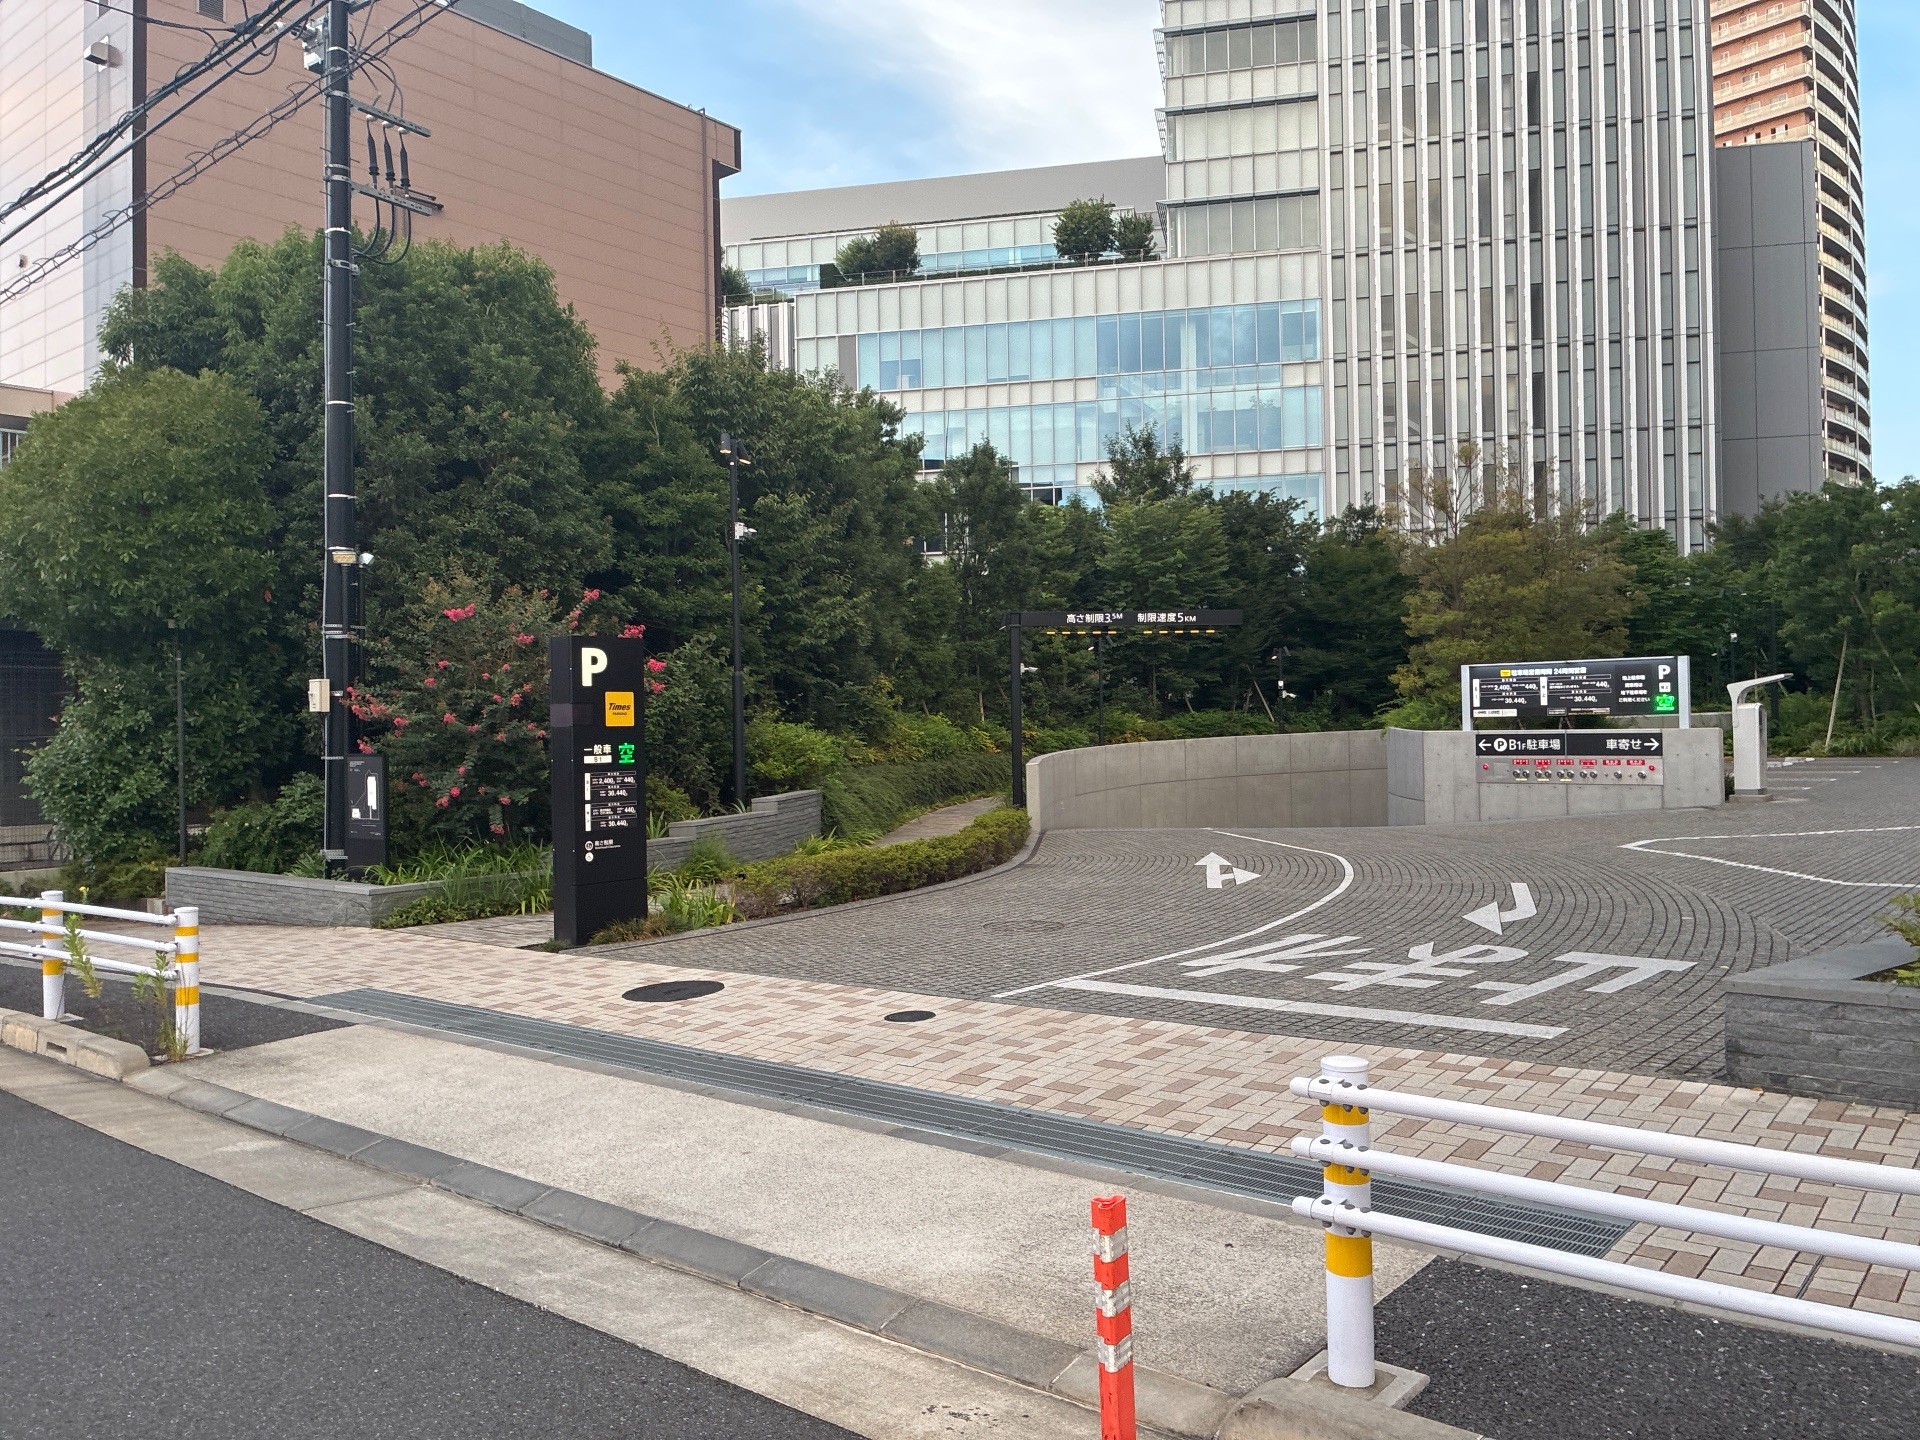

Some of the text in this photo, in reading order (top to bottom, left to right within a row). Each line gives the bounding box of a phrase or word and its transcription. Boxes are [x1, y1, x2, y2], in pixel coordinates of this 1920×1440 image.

[1137, 612, 1197, 623] 制限速度5KM
[581, 647, 608, 687] P
[1657, 664, 1671, 680] P
[608, 702, 631, 711] Times
[583, 744, 612, 755] 一般車
[1605, 738, 1642, 751] 車寄せ
[618, 742, 635, 764] 空
[1177, 933, 1698, 1006] 止まれ
